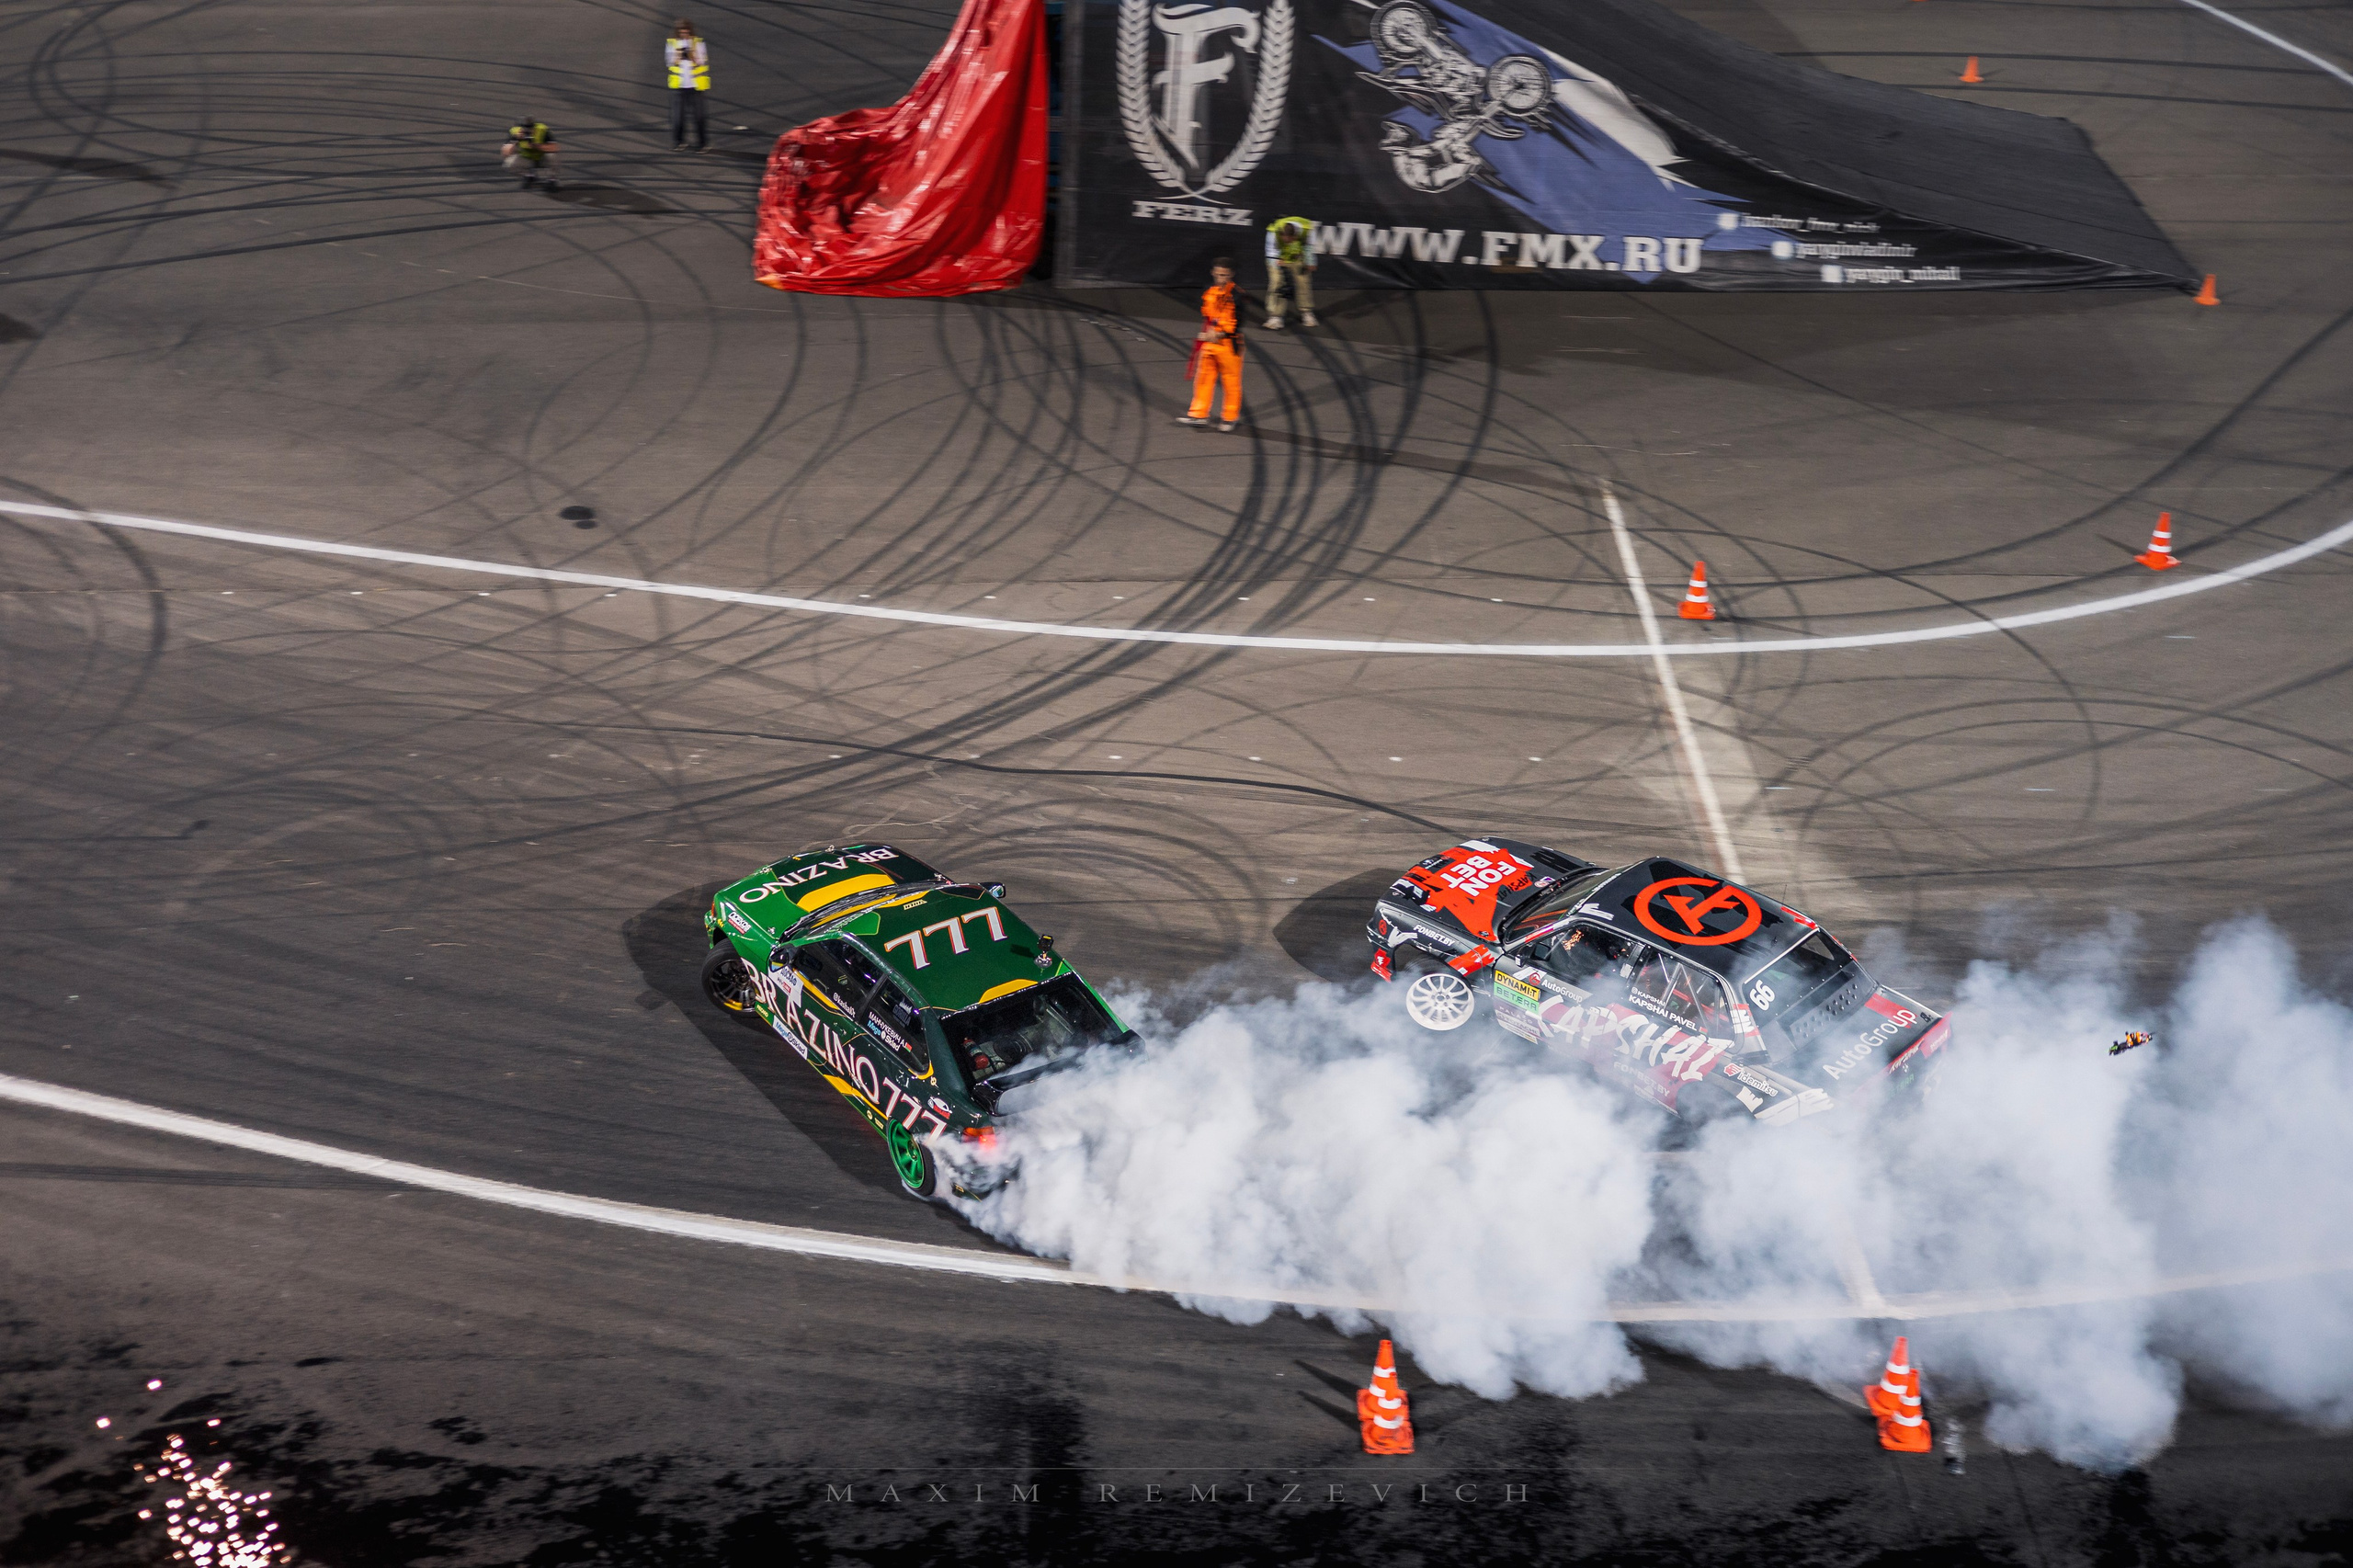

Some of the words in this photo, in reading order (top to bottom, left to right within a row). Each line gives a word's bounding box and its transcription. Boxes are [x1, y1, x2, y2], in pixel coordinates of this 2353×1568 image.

[1131, 200, 1254, 226] FERZ
[1309, 221, 1704, 273] WWW.FMX.RU
[739, 847, 900, 903] BRAZINO
[1440, 855, 1493, 889] BET
[1459, 861, 1518, 897] FON
[884, 906, 1008, 971] 777
[1413, 924, 1456, 947] FONBET.BY
[1541, 979, 1583, 1003] AutoGroup
[1749, 979, 1775, 1011] 66
[1629, 994, 1668, 1017] KAPSHAI
[1669, 1012, 1698, 1031] PAVEL
[1823, 1009, 1917, 1080] AutoGroup
[1737, 1070, 1779, 1097] idemitsu
